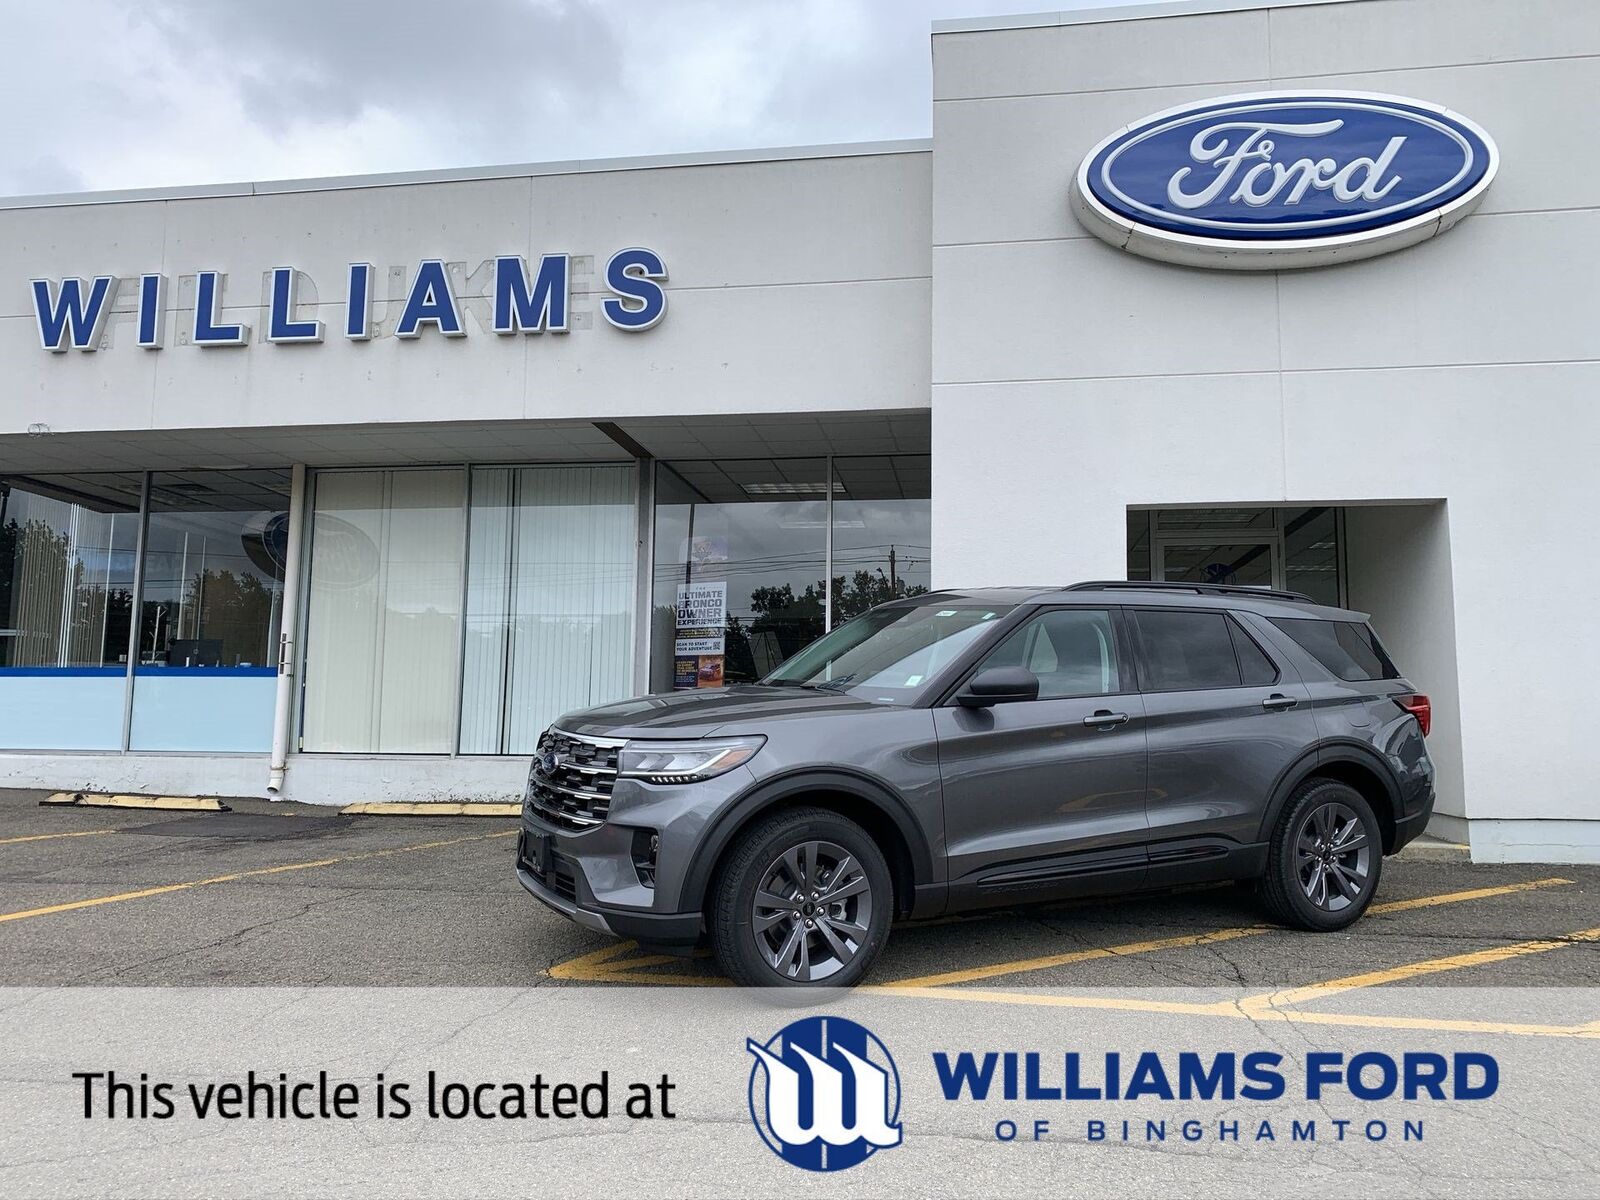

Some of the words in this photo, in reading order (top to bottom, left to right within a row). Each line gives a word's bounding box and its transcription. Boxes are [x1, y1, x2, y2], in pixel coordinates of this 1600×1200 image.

[1167, 118, 1408, 210] Ford
[30, 247, 669, 354] WILLIAMS
[678, 590, 723, 600] ULTIMATE
[678, 599, 722, 609] BRONCO
[677, 608, 722, 619] OWNER
[677, 618, 722, 626] EXPERIENCE
